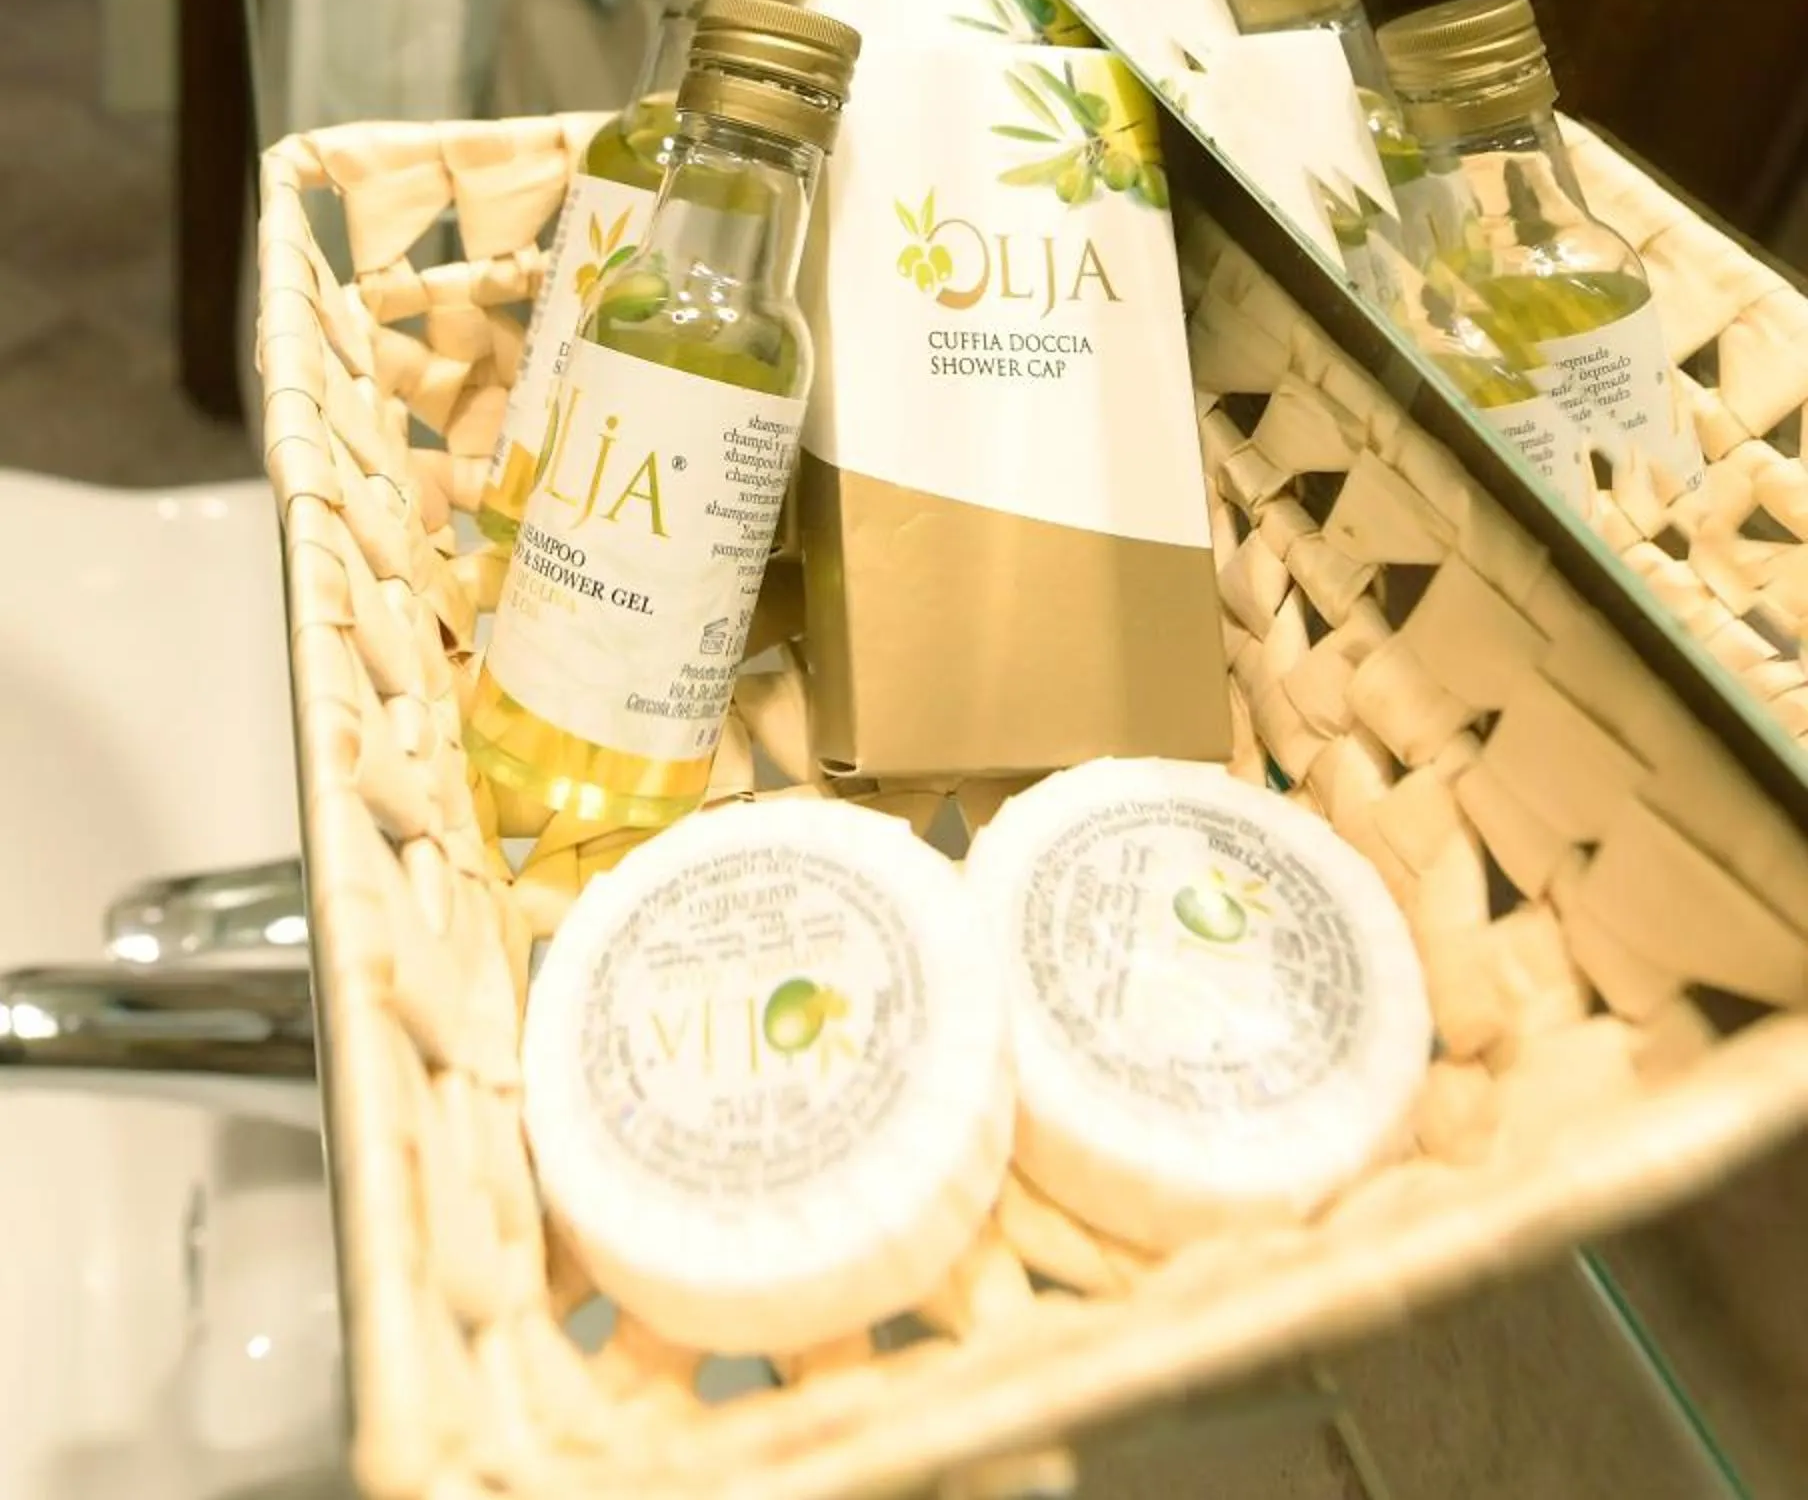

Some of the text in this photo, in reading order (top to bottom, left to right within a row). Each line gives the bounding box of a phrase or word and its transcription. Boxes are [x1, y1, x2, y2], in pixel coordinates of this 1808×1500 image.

[927, 330, 1094, 355] CUFFIA DOCCIA
[930, 354, 1067, 379] SHOWER CAP
[531, 552, 606, 601] SHOWER
[610, 587, 655, 616] GEL
